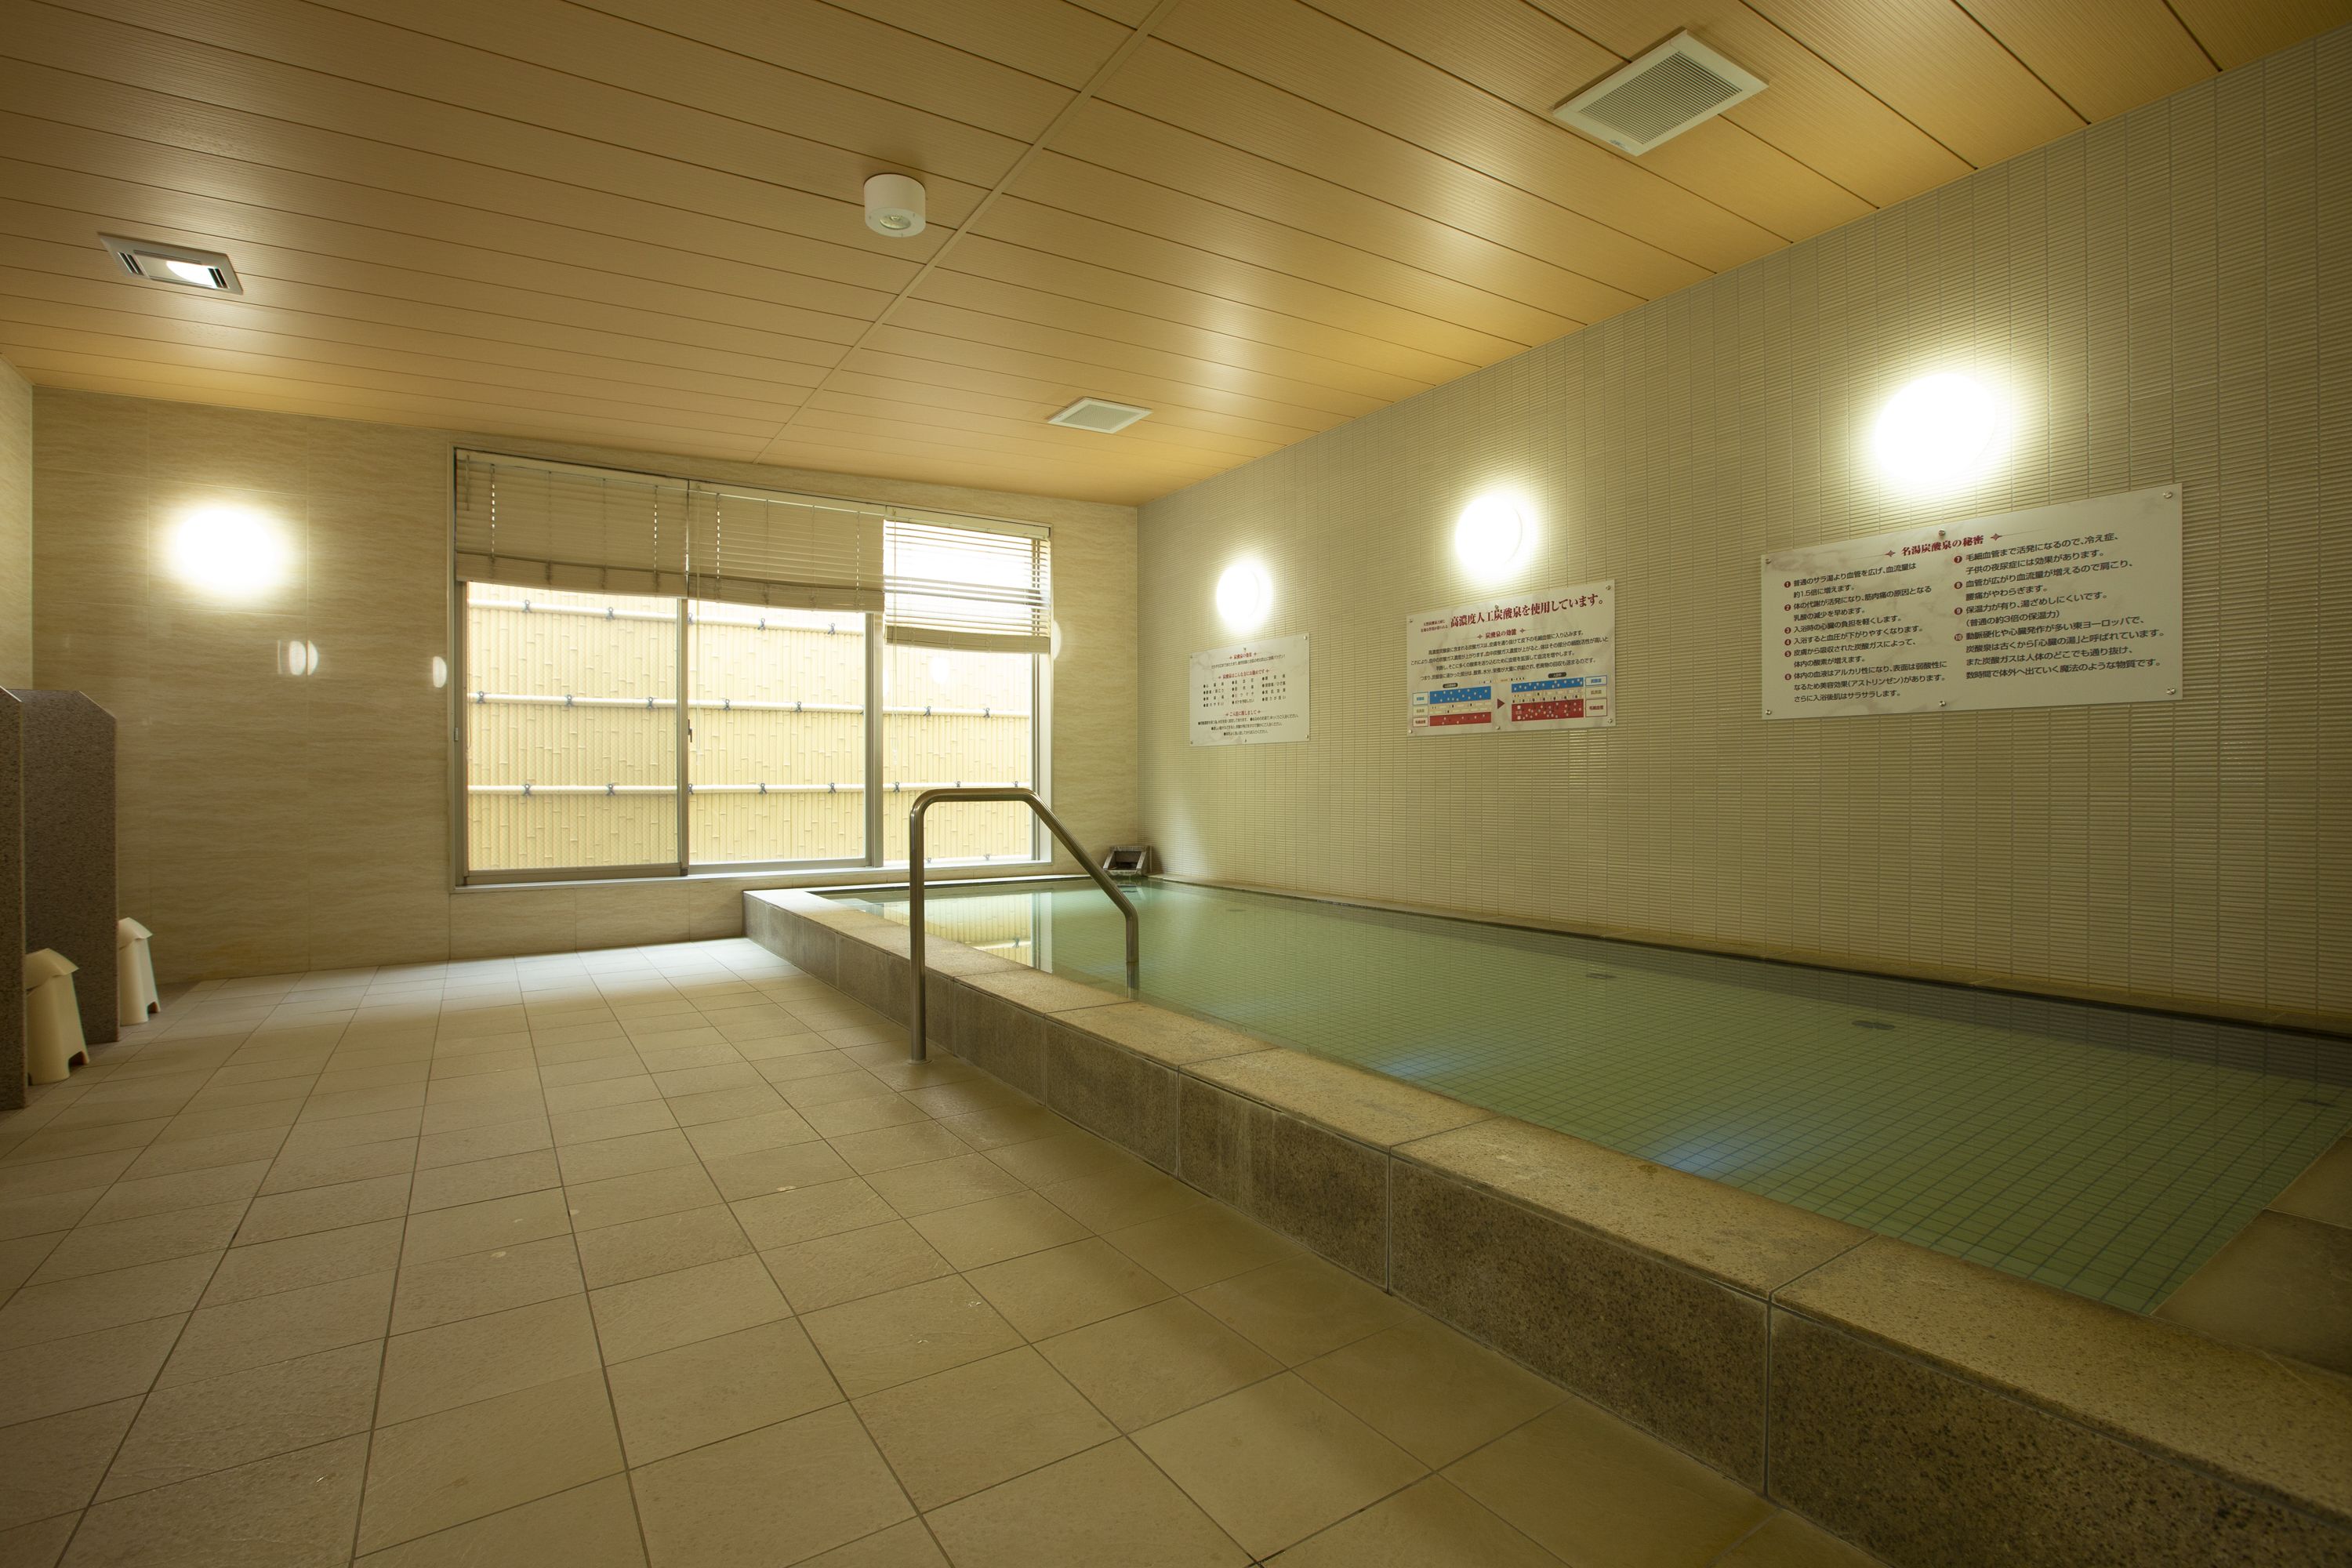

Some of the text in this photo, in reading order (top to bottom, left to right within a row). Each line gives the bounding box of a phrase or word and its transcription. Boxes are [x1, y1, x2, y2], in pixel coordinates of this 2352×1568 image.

[1901, 535, 1984, 556] 名湯炭酸泉の秘密
[1965, 550, 2103, 575] 子供の夜尿症には効果があります。
[1794, 563, 1916, 586] 普通のサラ湯より血管を広げ、血流量は
[1966, 560, 2132, 588] 血管が広がり血流量が増えるので肩こり、
[1794, 584, 1855, 598] 約1.5倍に増えます。
[1965, 585, 2048, 601] 腰痛がやわらぎます。
[1450, 593, 1603, 628] 高濃度人工炭酸泉を使用しています。
[1794, 607, 1865, 622] 乳酸の減少を早めます。
[1794, 615, 1901, 633] 入浴時の心臓の負担を軽くします。
[1794, 626, 1922, 644] 入浴すると血圧が下がりやすくなります。
[1794, 656, 1865, 668] 体内の酸素が増えます。
[1966, 659, 2160, 679] 数時間で体外へ出ていく魔法のような物質です。
[1794, 690, 1900, 702] さらに入浴後肌はサラサラします。
